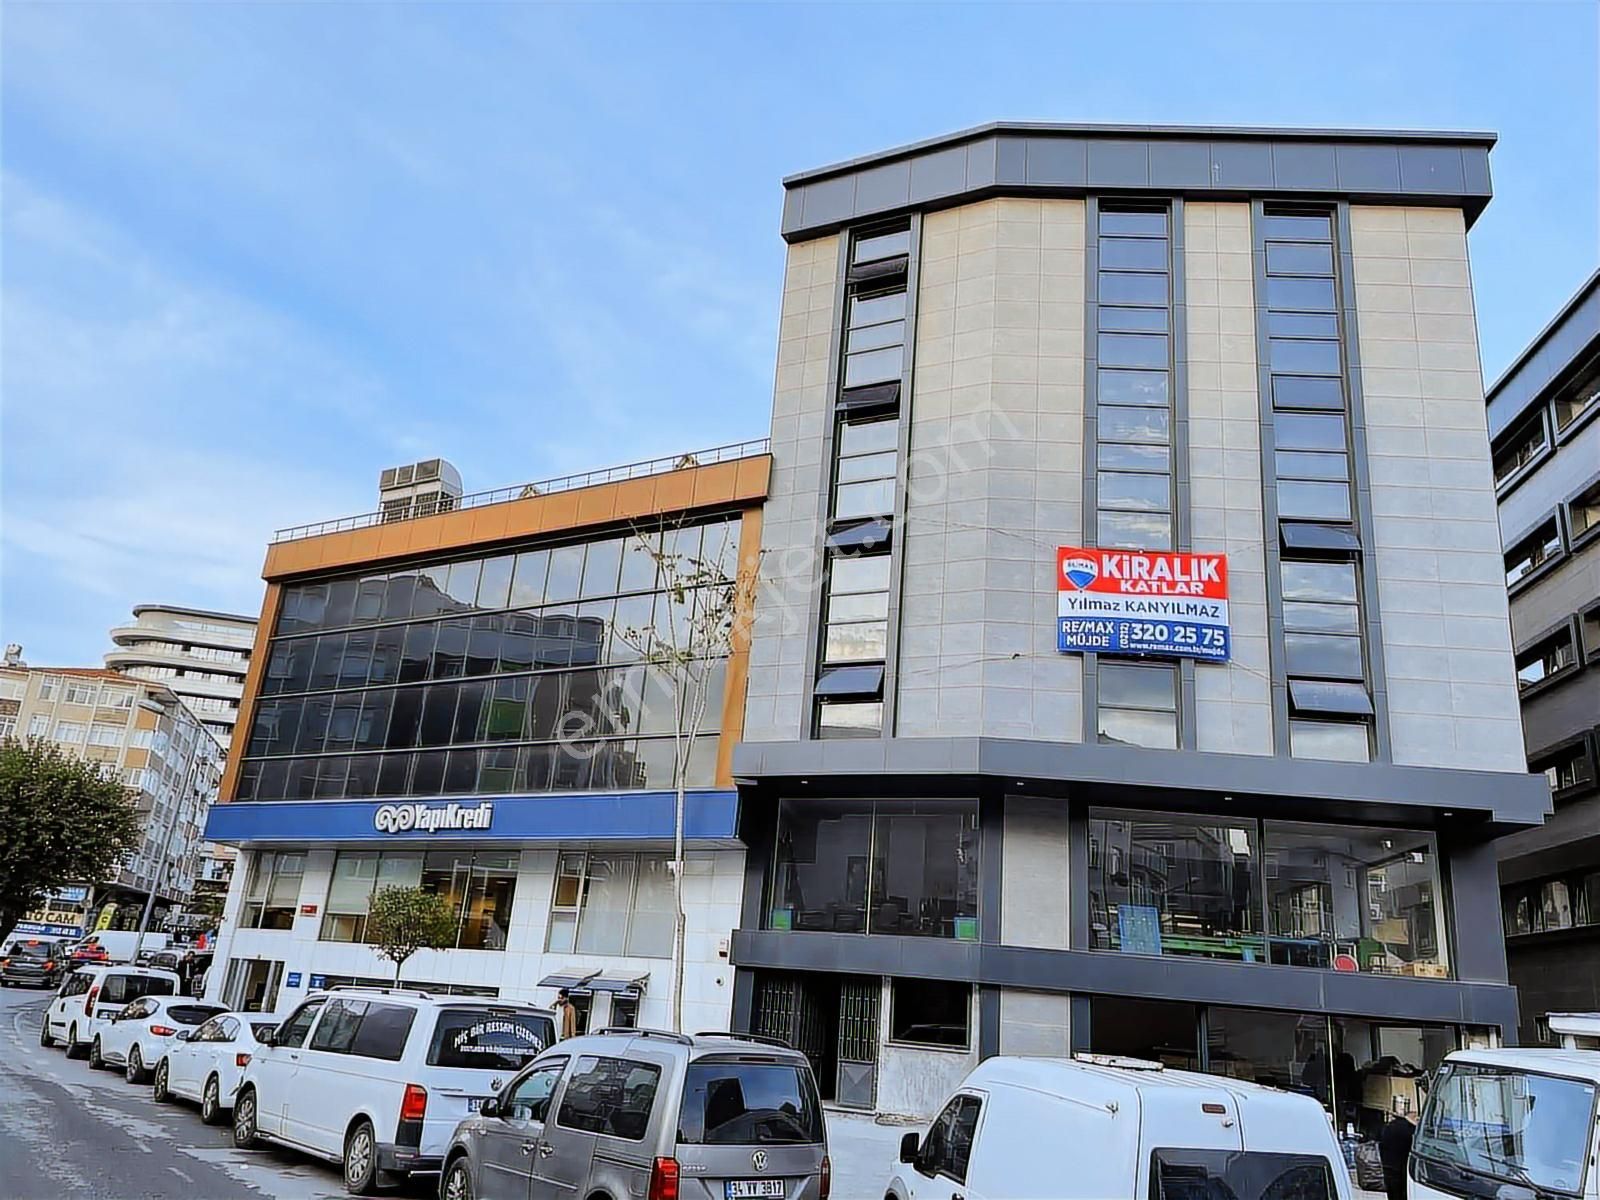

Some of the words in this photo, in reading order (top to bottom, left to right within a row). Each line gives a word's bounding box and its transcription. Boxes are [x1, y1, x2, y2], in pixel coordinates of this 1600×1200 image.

[1120, 579, 1204, 594] KATLAR
[1068, 597, 1120, 612] Yılmaz
[1125, 601, 1220, 618] KANYILMAZ
[1062, 621, 1114, 634] RE/MAX
[1131, 623, 1168, 641] 320
[1173, 626, 1197, 643] 25
[1201, 628, 1225, 646] 75
[46, 912, 75, 924] CAM
